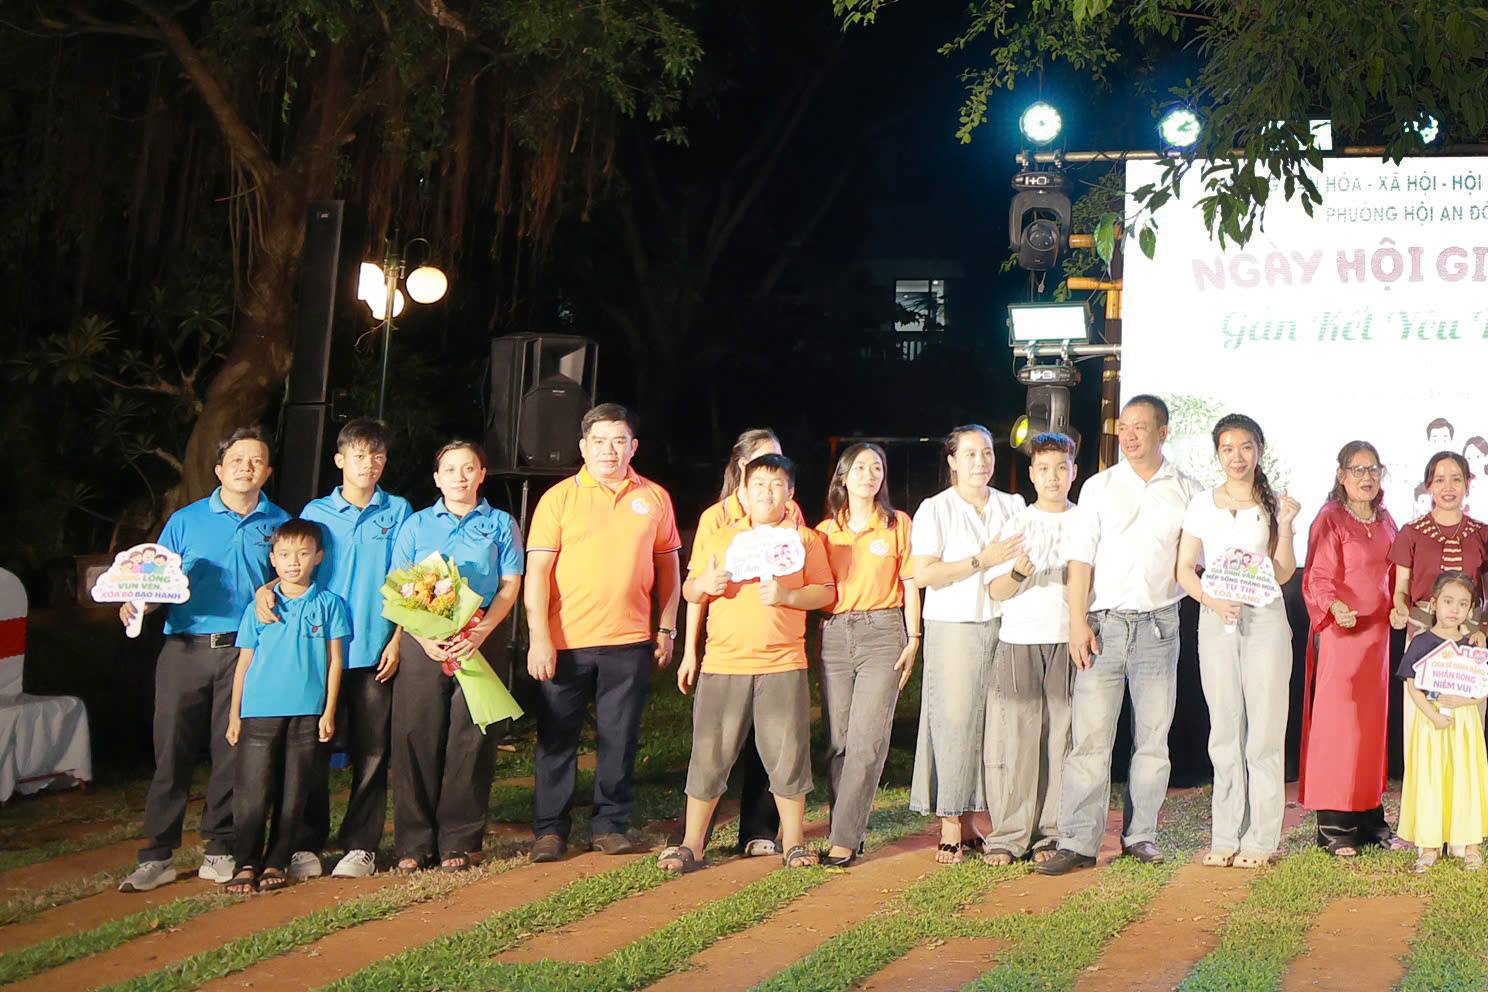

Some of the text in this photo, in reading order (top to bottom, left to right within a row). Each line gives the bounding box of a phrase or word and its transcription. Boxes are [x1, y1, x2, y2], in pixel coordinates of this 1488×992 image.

[1407, 171, 1436, 195] HỘI
[1452, 170, 1481, 195] HỘI
[1404, 201, 1433, 226] HỘI
[1440, 205, 1463, 221] AN
[1192, 241, 1323, 292] NGÀY
[1336, 237, 1425, 291] HỘI
